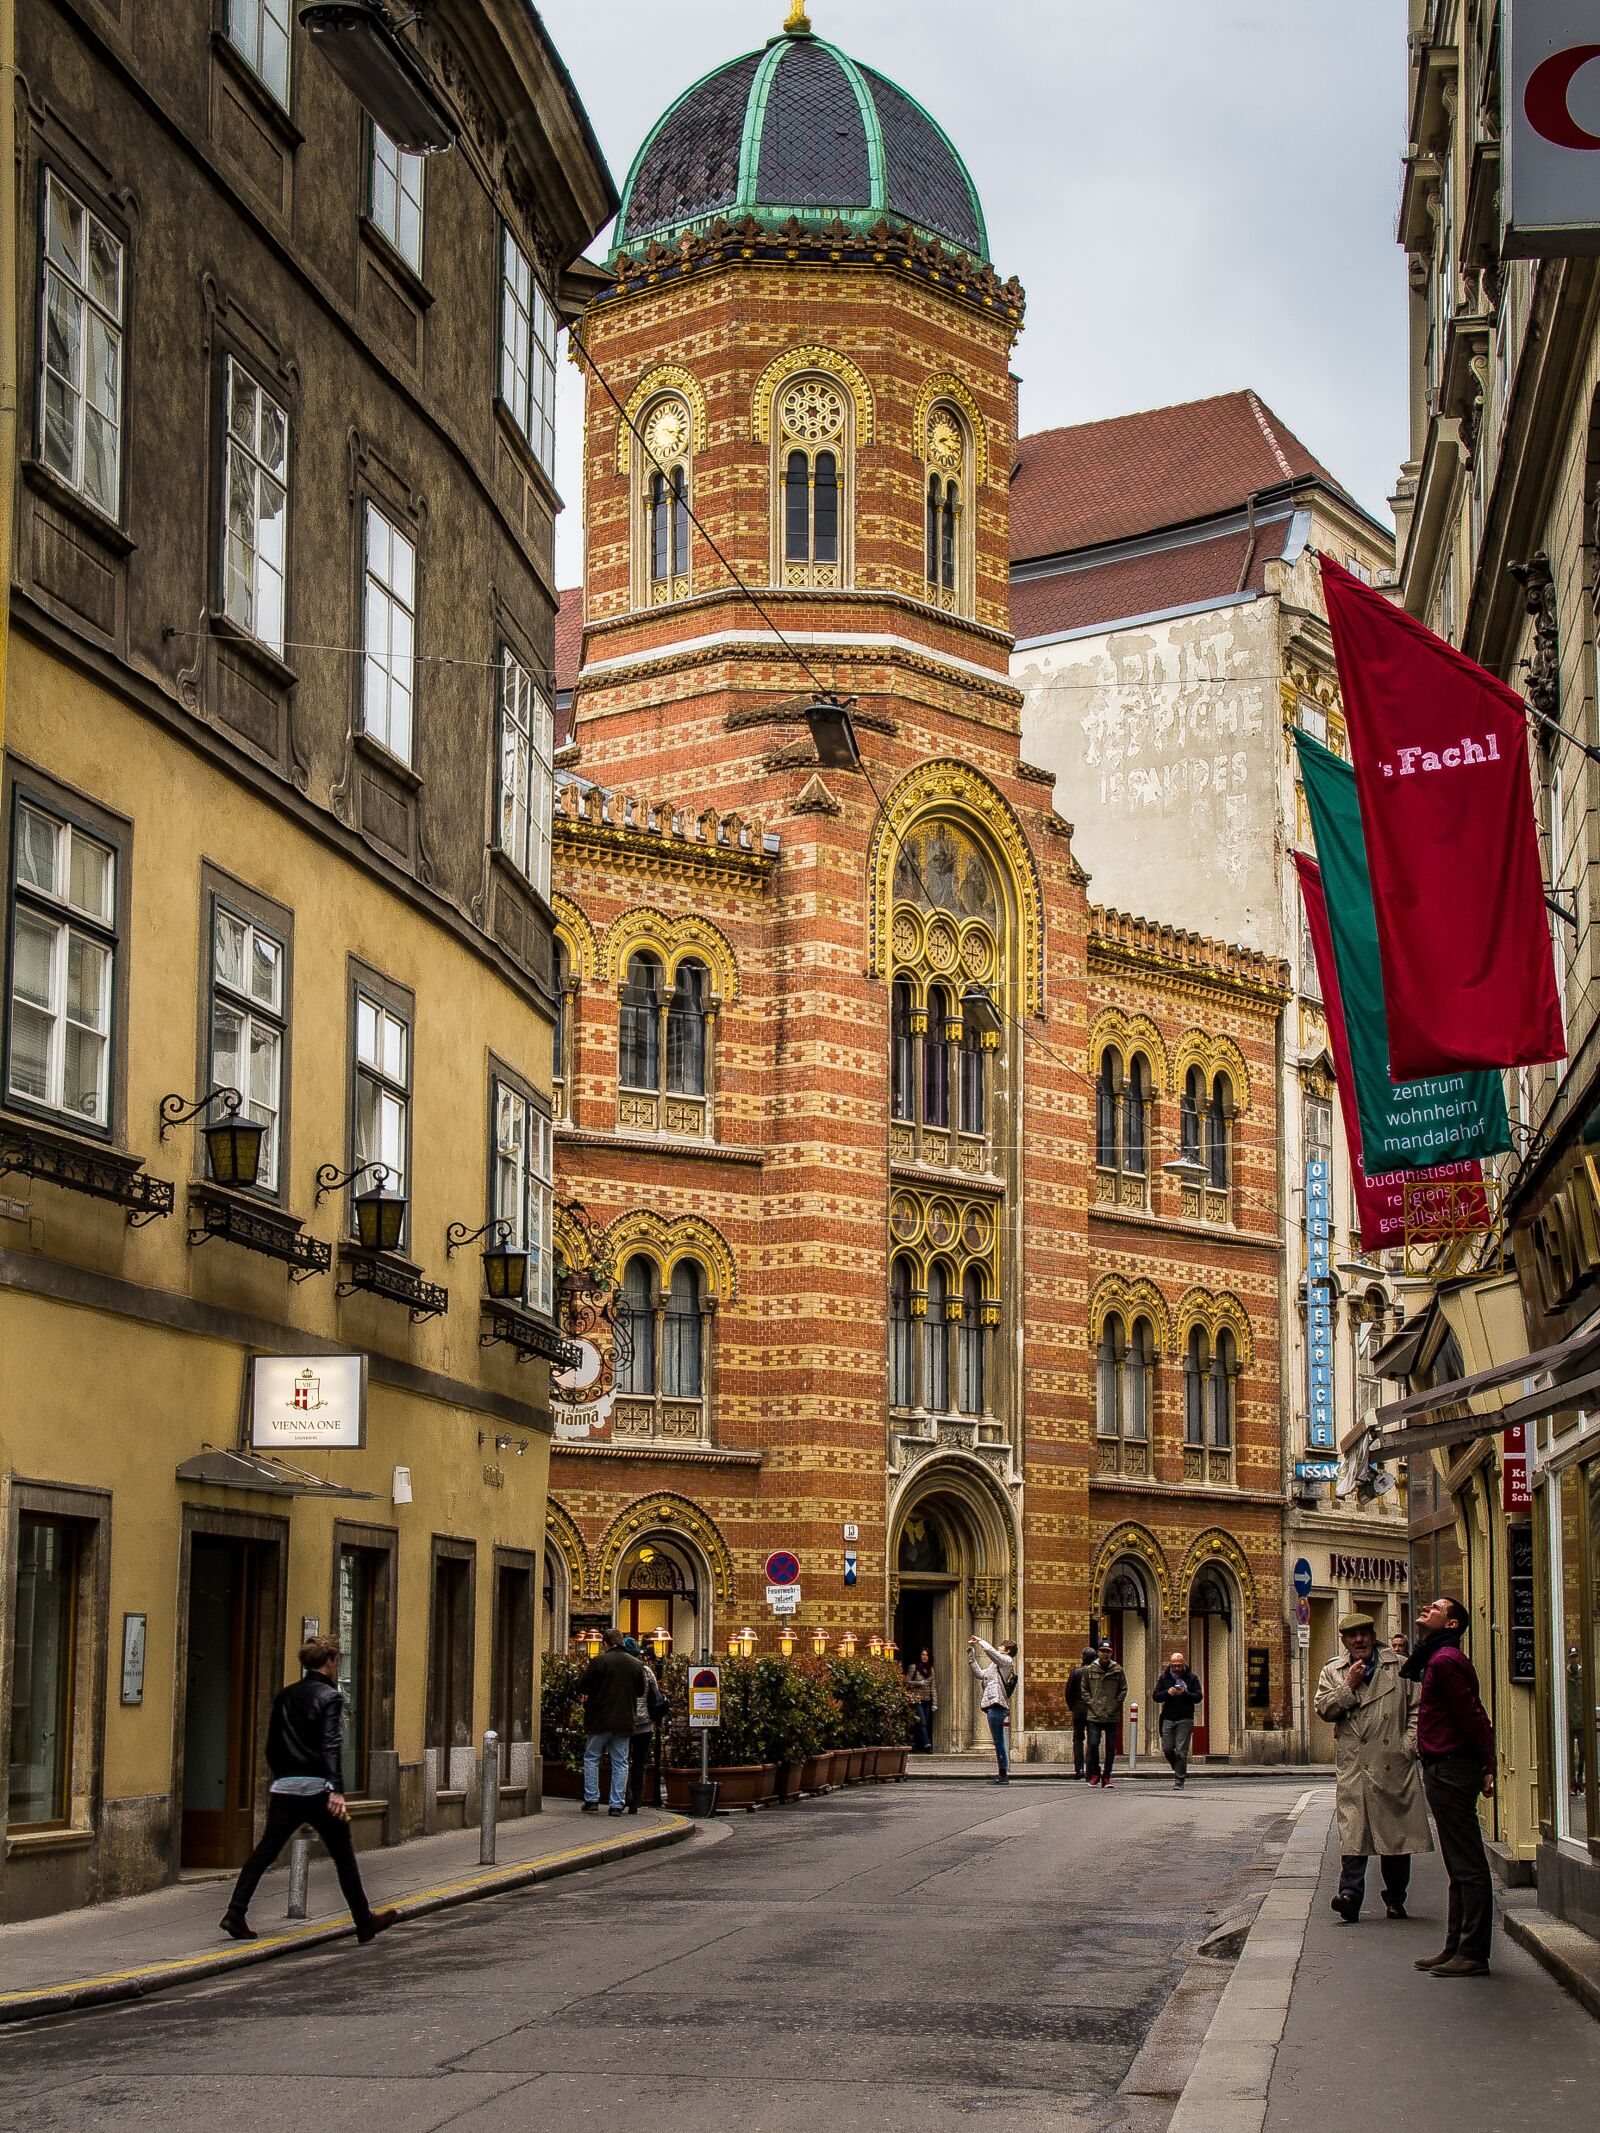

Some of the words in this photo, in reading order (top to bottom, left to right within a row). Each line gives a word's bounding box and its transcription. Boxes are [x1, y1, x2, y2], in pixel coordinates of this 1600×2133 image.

[1397, 733, 1500, 775] Fachl
[1392, 1077, 1464, 1101] zentrum
[1386, 1099, 1478, 1126] wohnheim
[1384, 1118, 1486, 1151] mandalahof
[1365, 1160, 1472, 1188] buddhistische
[1387, 1186, 1451, 1207] reigions
[1311, 1163, 1323, 1276] ORIENT
[1312, 1289, 1327, 1442] TEPPICHE
[576, 1403, 597, 1414] Boutique
[272, 1420, 315, 1430] VIENNA
[317, 1420, 341, 1430] ONE
[848, 1525, 855, 1536] 13
[1335, 1554, 1409, 1583] ISSAKIDES
